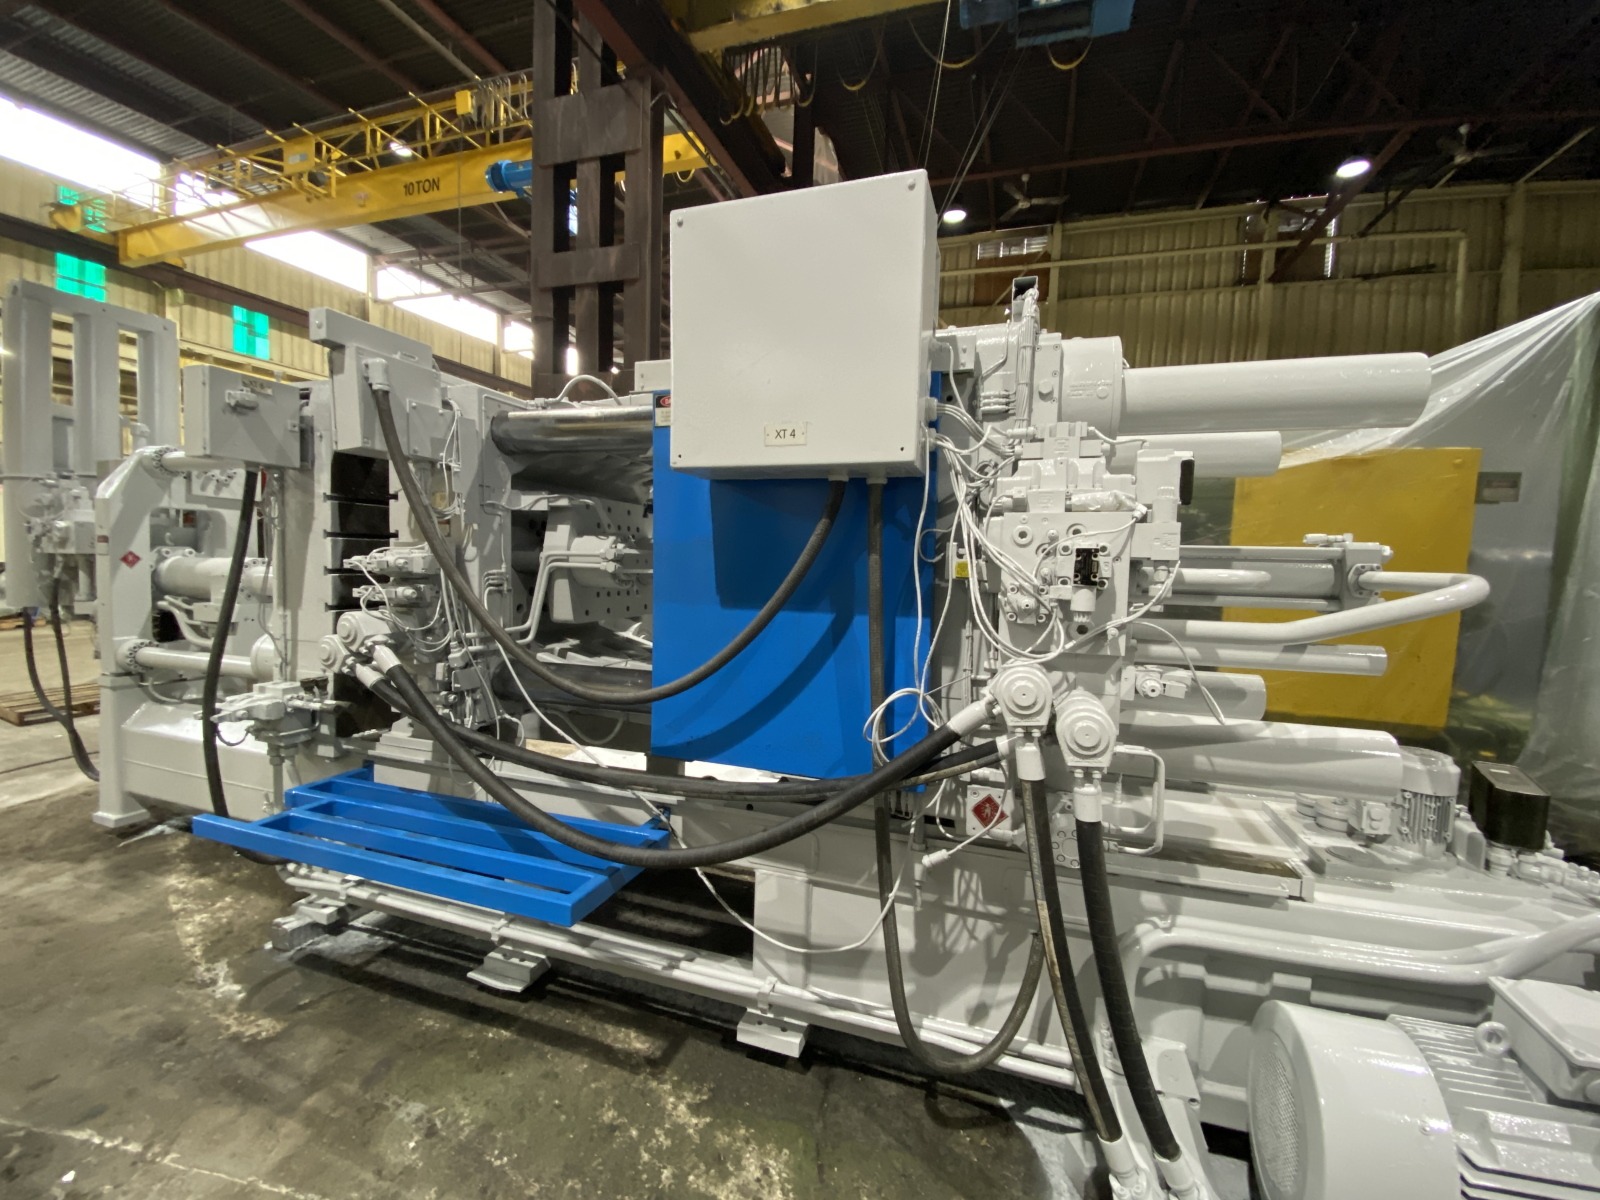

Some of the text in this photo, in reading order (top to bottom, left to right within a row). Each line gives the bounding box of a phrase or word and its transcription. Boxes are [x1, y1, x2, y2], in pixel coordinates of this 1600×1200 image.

[403, 176, 440, 197] 10 TON
[774, 428, 796, 440] XT 4
